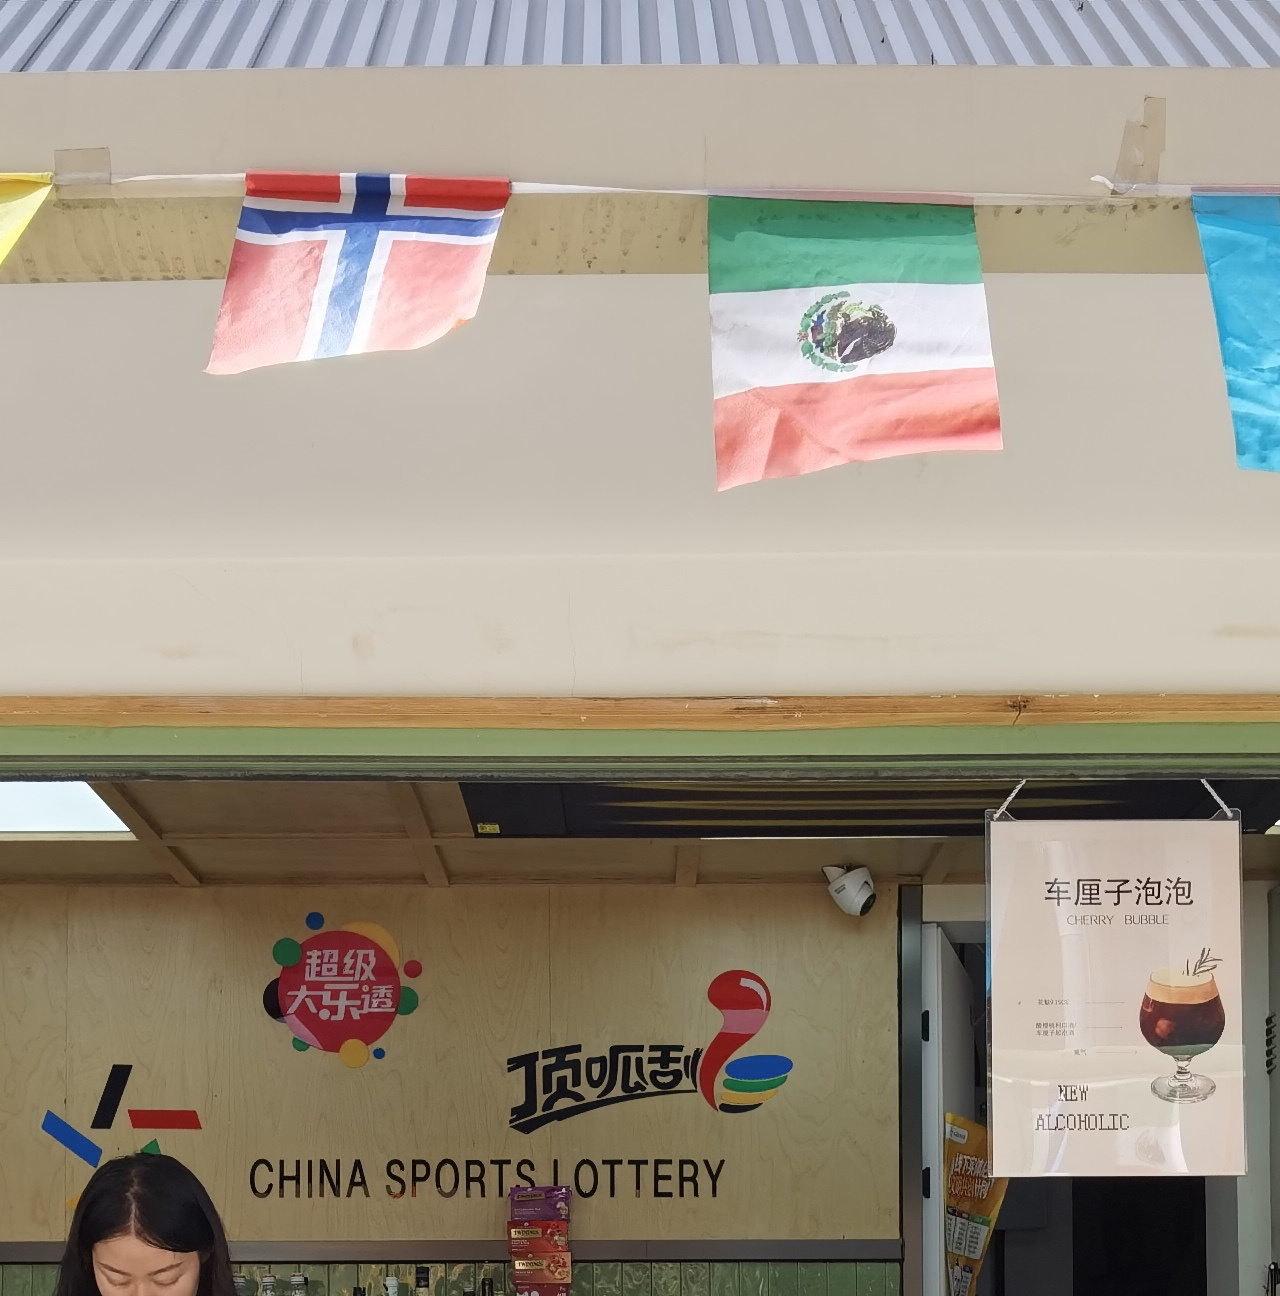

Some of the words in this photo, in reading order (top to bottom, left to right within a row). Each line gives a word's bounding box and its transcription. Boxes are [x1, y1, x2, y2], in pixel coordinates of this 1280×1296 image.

[1044, 876, 1194, 907] 车厘子泡泡
[1067, 914, 1114, 925] CHERRY
[1124, 914, 1169, 925] BUBBLE
[305, 949, 377, 981] 超级
[286, 984, 396, 1021] 大乐透
[1058, 1085, 1088, 1102] NEW
[1035, 1113, 1130, 1131] ALCOHOLIC
[249, 1159, 367, 1199] CHINA
[385, 1158, 537, 1199] SPORTS
